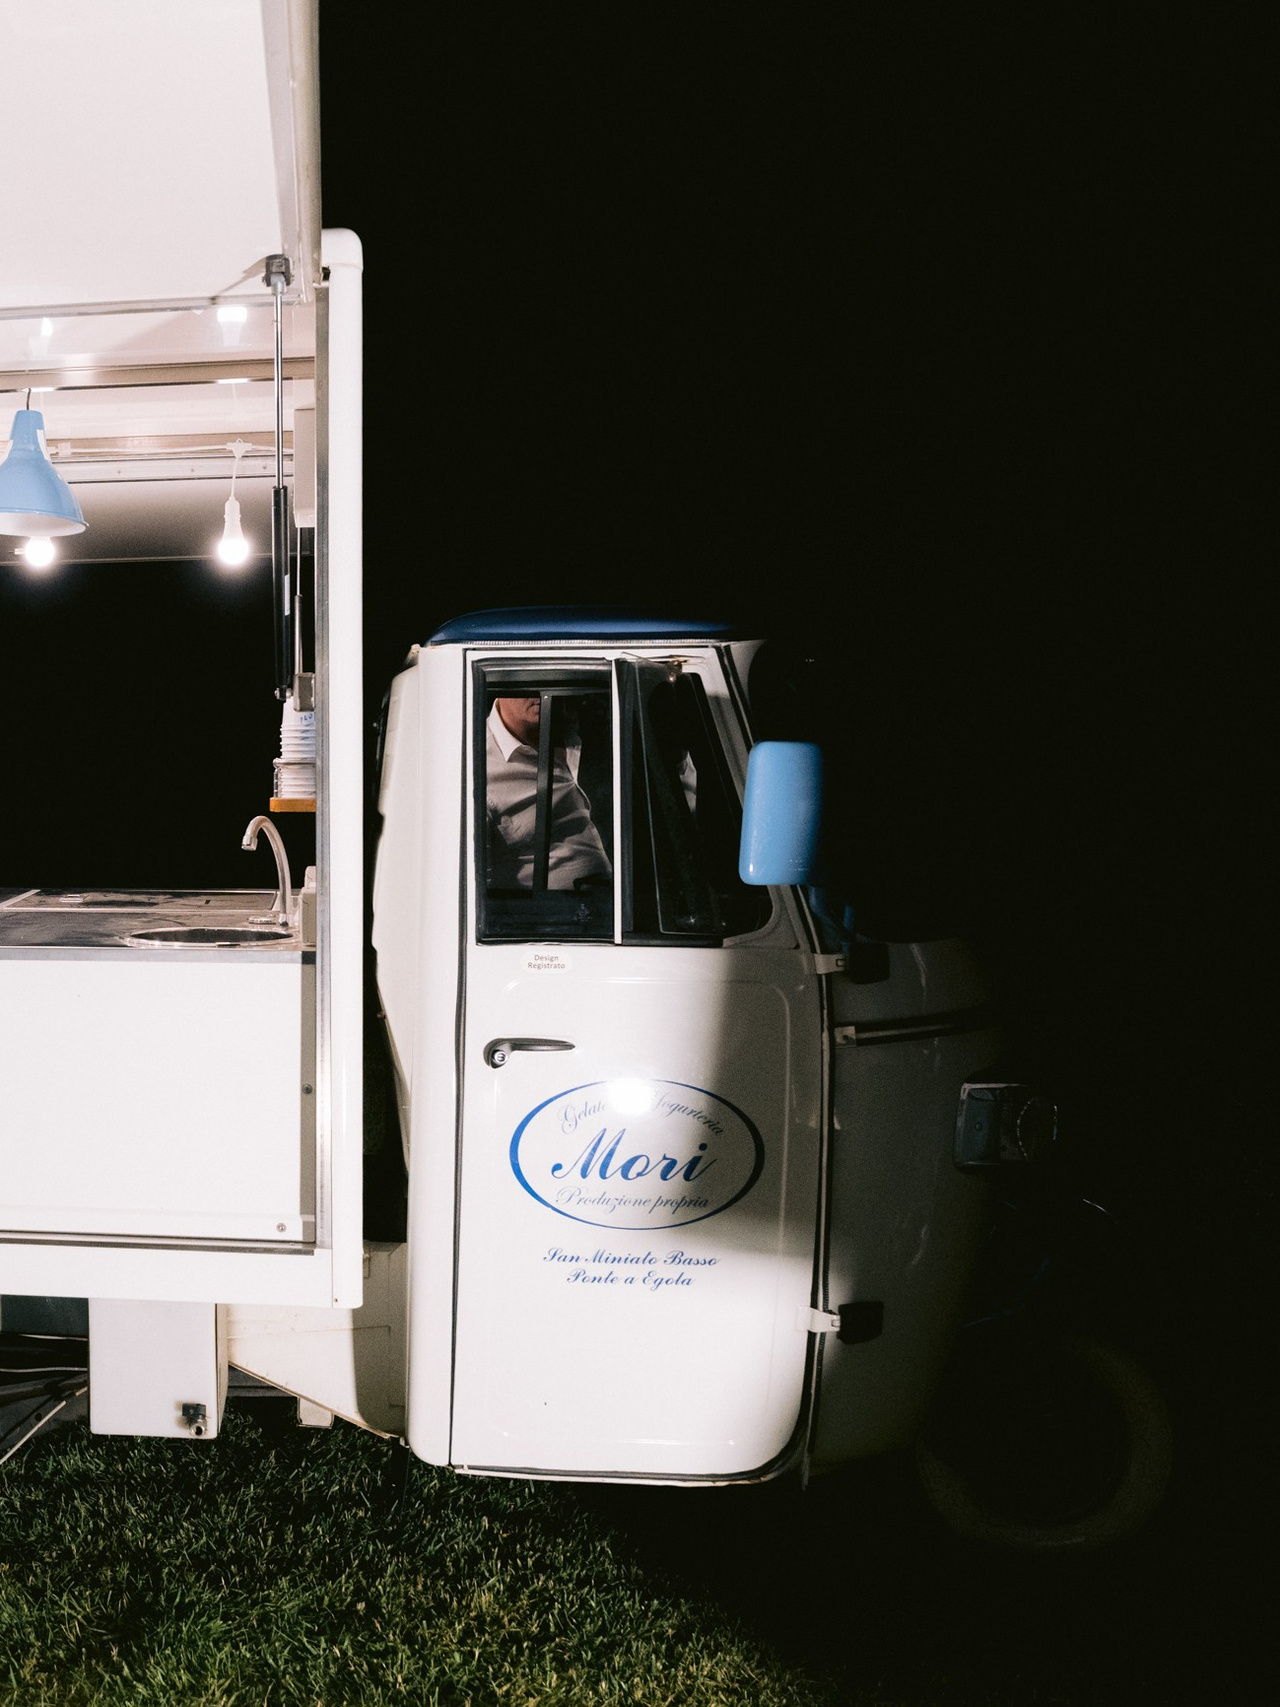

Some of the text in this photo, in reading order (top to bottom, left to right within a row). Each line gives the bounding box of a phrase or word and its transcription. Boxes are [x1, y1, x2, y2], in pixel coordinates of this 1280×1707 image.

[527, 962, 566, 971] Registrato
[534, 954, 559, 962] Design
[550, 1127, 718, 1182] Mori
[555, 1186, 710, 1214] Produzione propria
[543, 1247, 720, 1267] San Miniato Basso
[566, 1268, 695, 1291] Ponte a Egola
